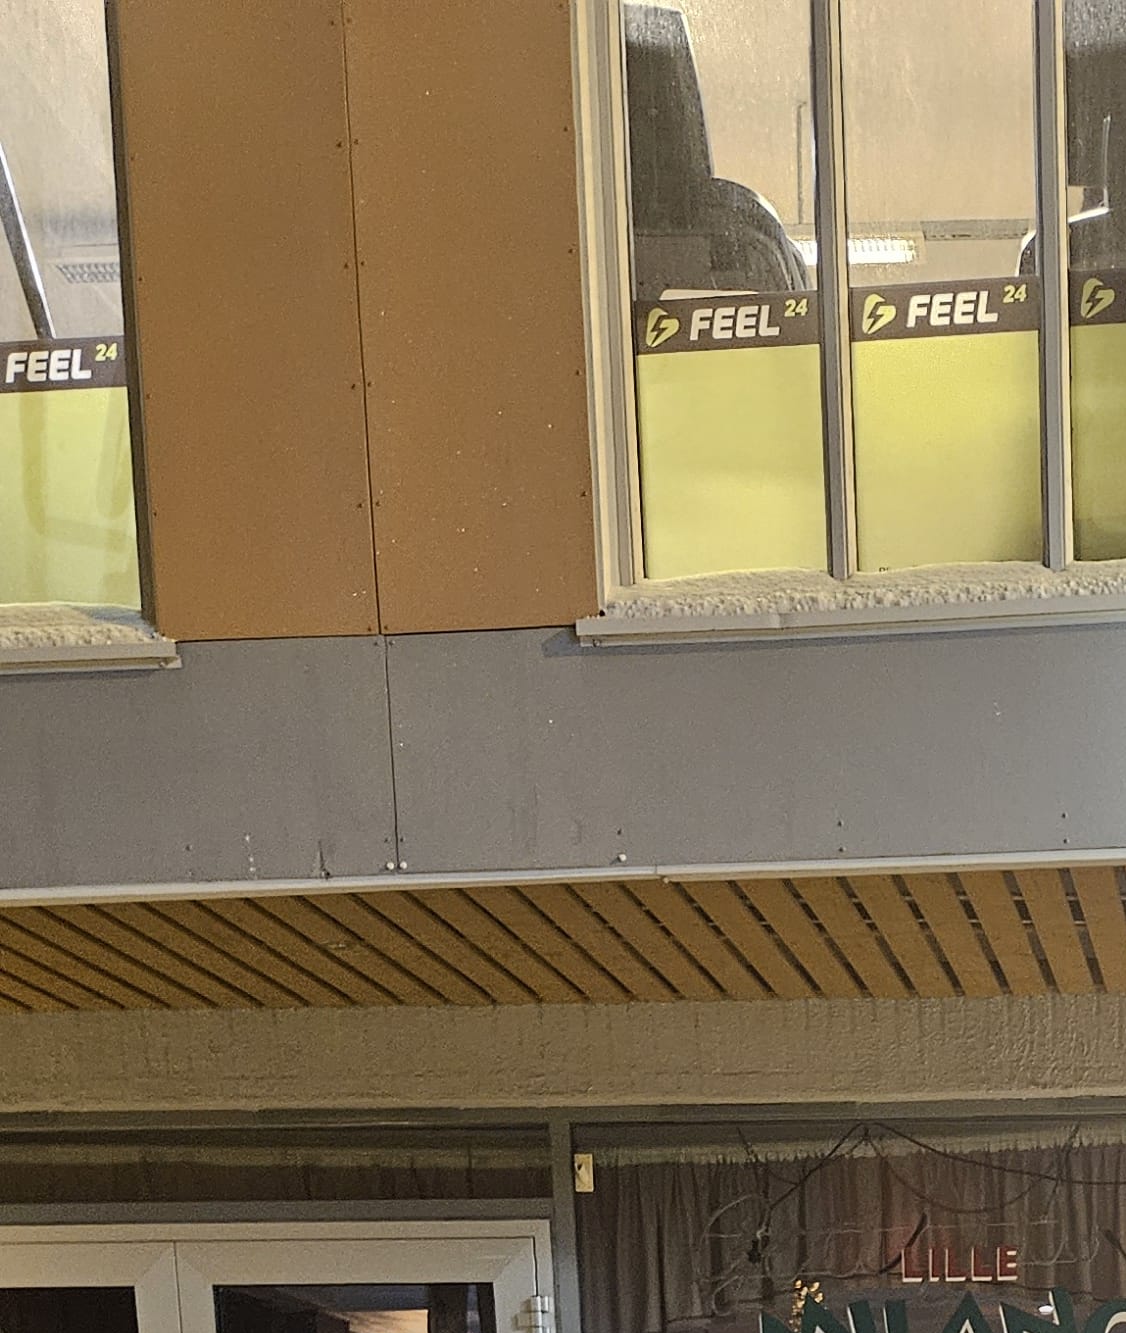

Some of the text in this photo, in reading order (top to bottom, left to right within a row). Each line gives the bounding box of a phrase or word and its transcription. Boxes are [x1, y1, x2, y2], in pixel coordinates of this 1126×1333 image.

[689, 298, 809, 341] FEEL 24
[905, 285, 1028, 328] FEEL 24
[5, 343, 118, 383] FEEL 24
[901, 1246, 1019, 1283] LILLE
